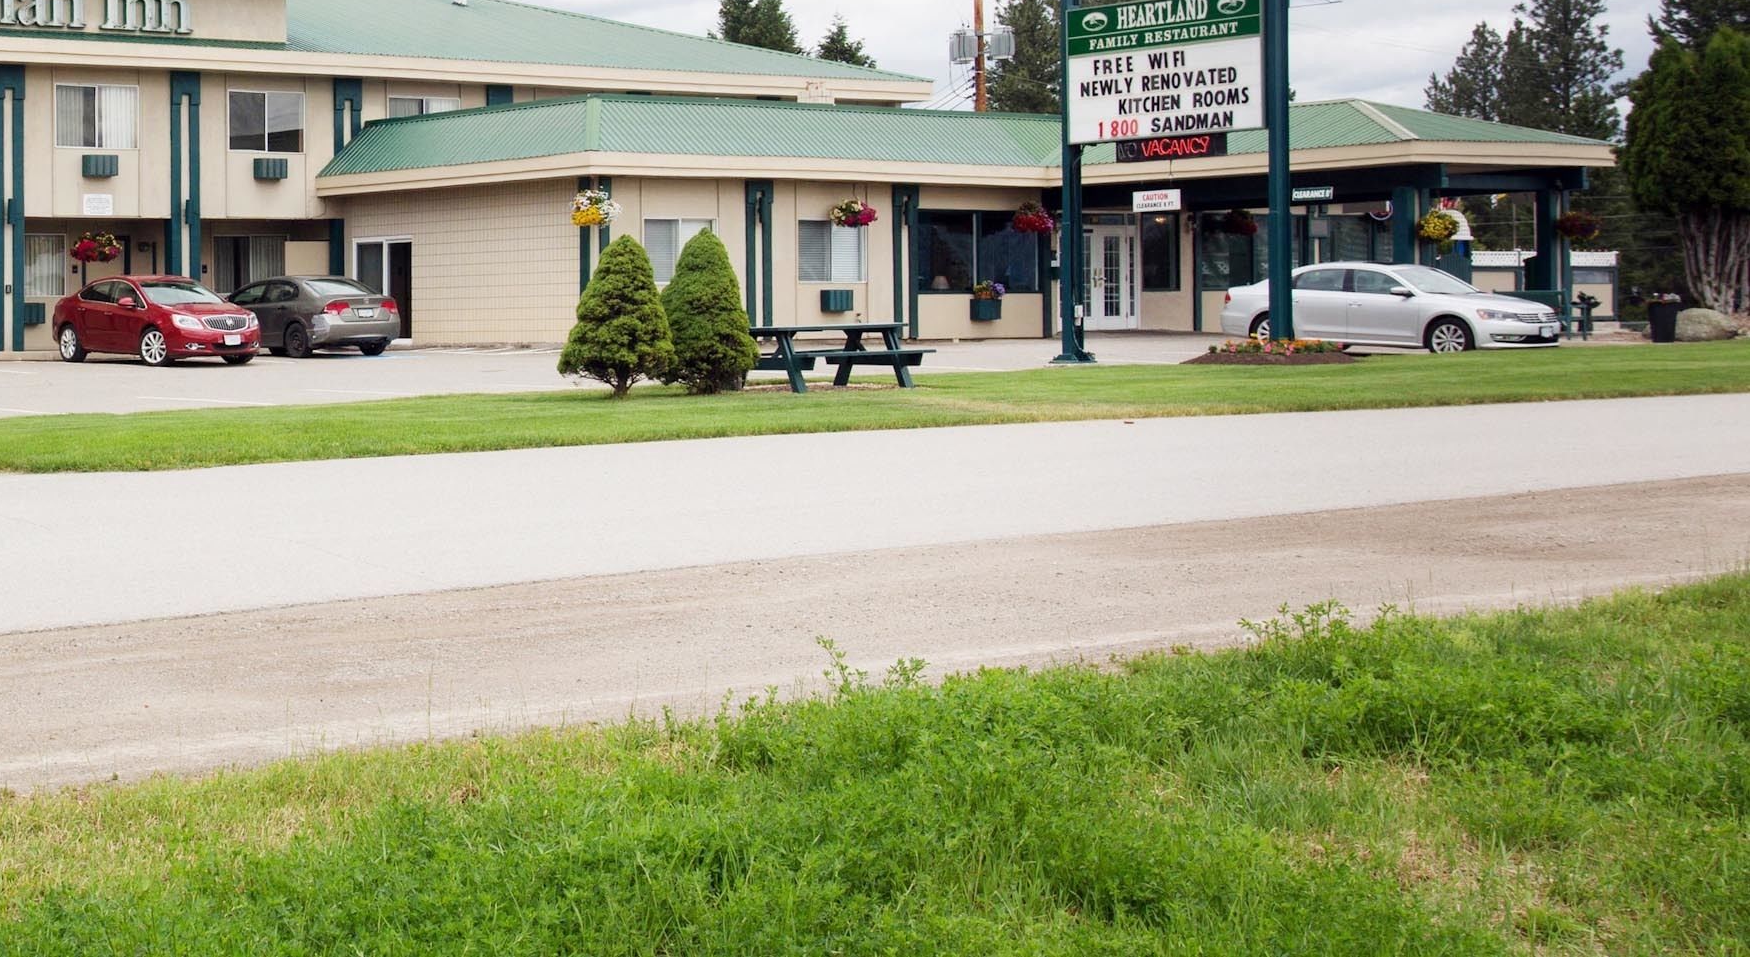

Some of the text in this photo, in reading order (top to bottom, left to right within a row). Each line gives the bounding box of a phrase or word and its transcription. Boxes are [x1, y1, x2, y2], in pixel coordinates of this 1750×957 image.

[1089, 21, 1238, 51] FAMILY RESTAURANT
[1093, 56, 1134, 75] FREE
[1080, 66, 1237, 97] NEWLY RENOVATED
[1119, 87, 1249, 115] KITCHEN ROOMS
[1110, 119, 1139, 137] 800
[1151, 111, 1233, 133] SANDMAN
[1141, 136, 1210, 157] VACANCY
[1143, 193, 1168, 201] CAUTION
[1294, 190, 1325, 199] CLEARANCE
